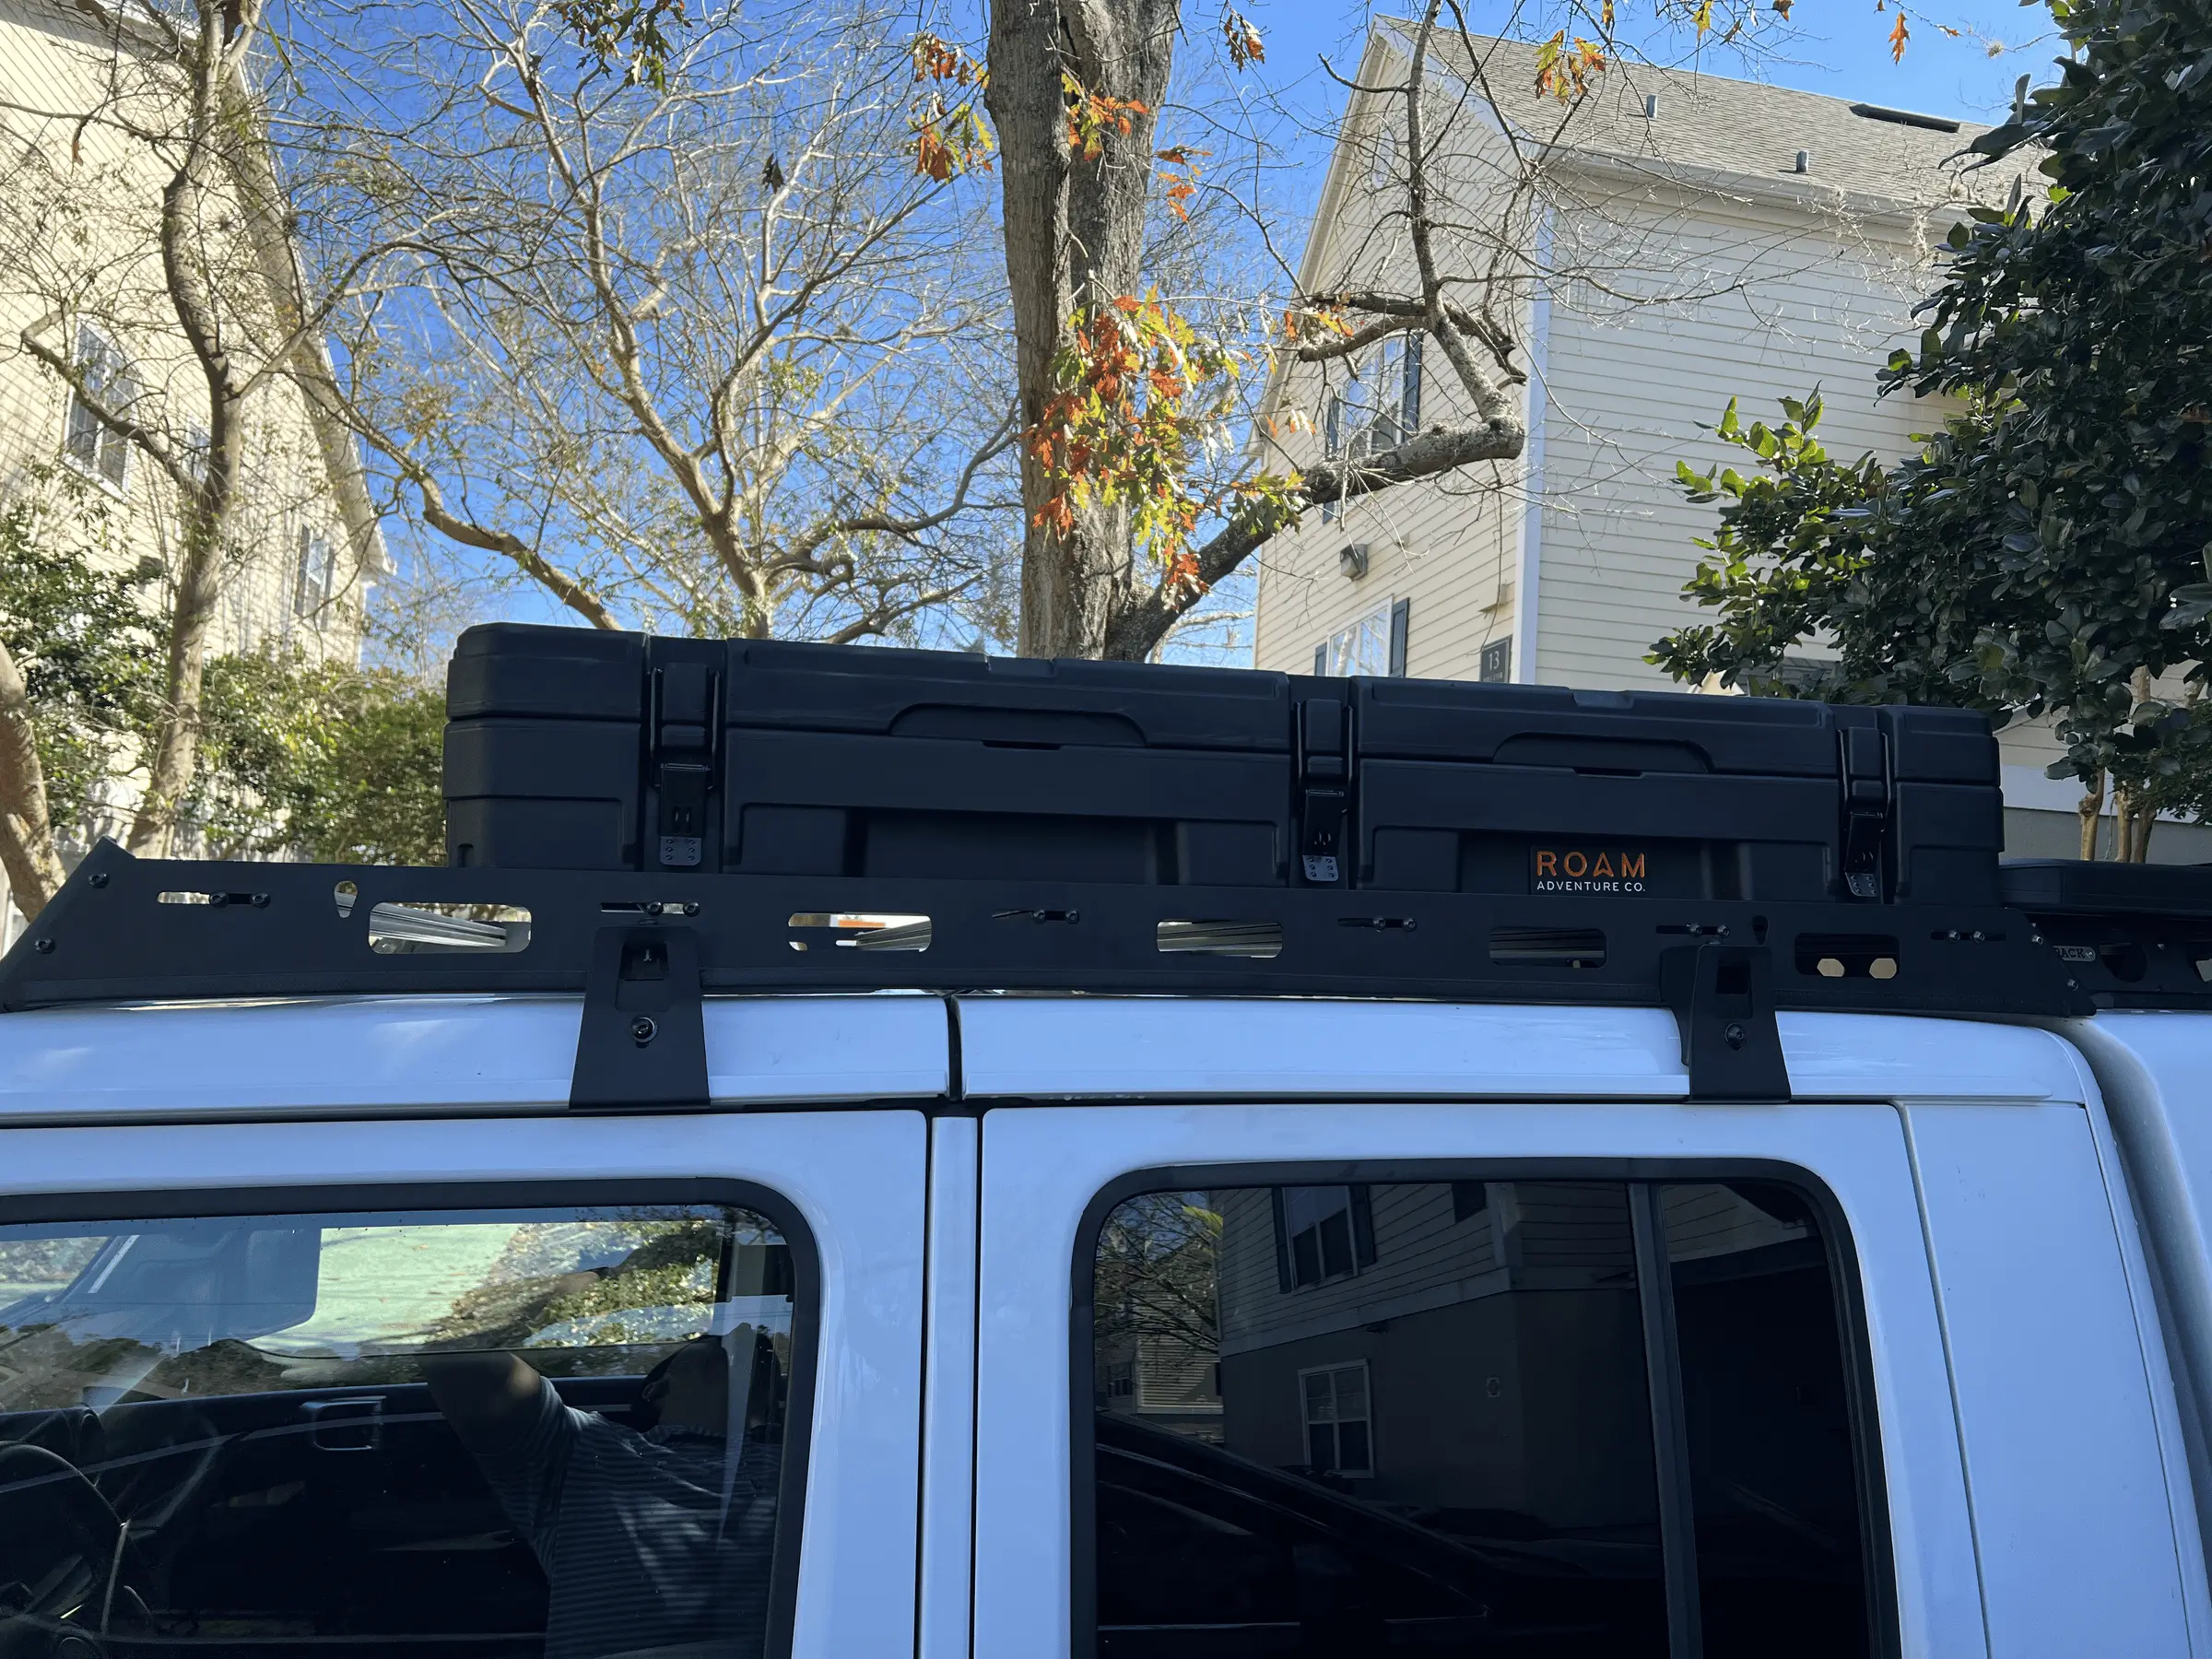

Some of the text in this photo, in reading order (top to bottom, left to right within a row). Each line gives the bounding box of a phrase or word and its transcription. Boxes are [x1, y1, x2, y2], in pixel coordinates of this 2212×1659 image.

[1488, 651, 1500, 671] 13
[1536, 851, 1646, 878] ROAM
[1536, 881, 1646, 892] ADVENTURE CO.
